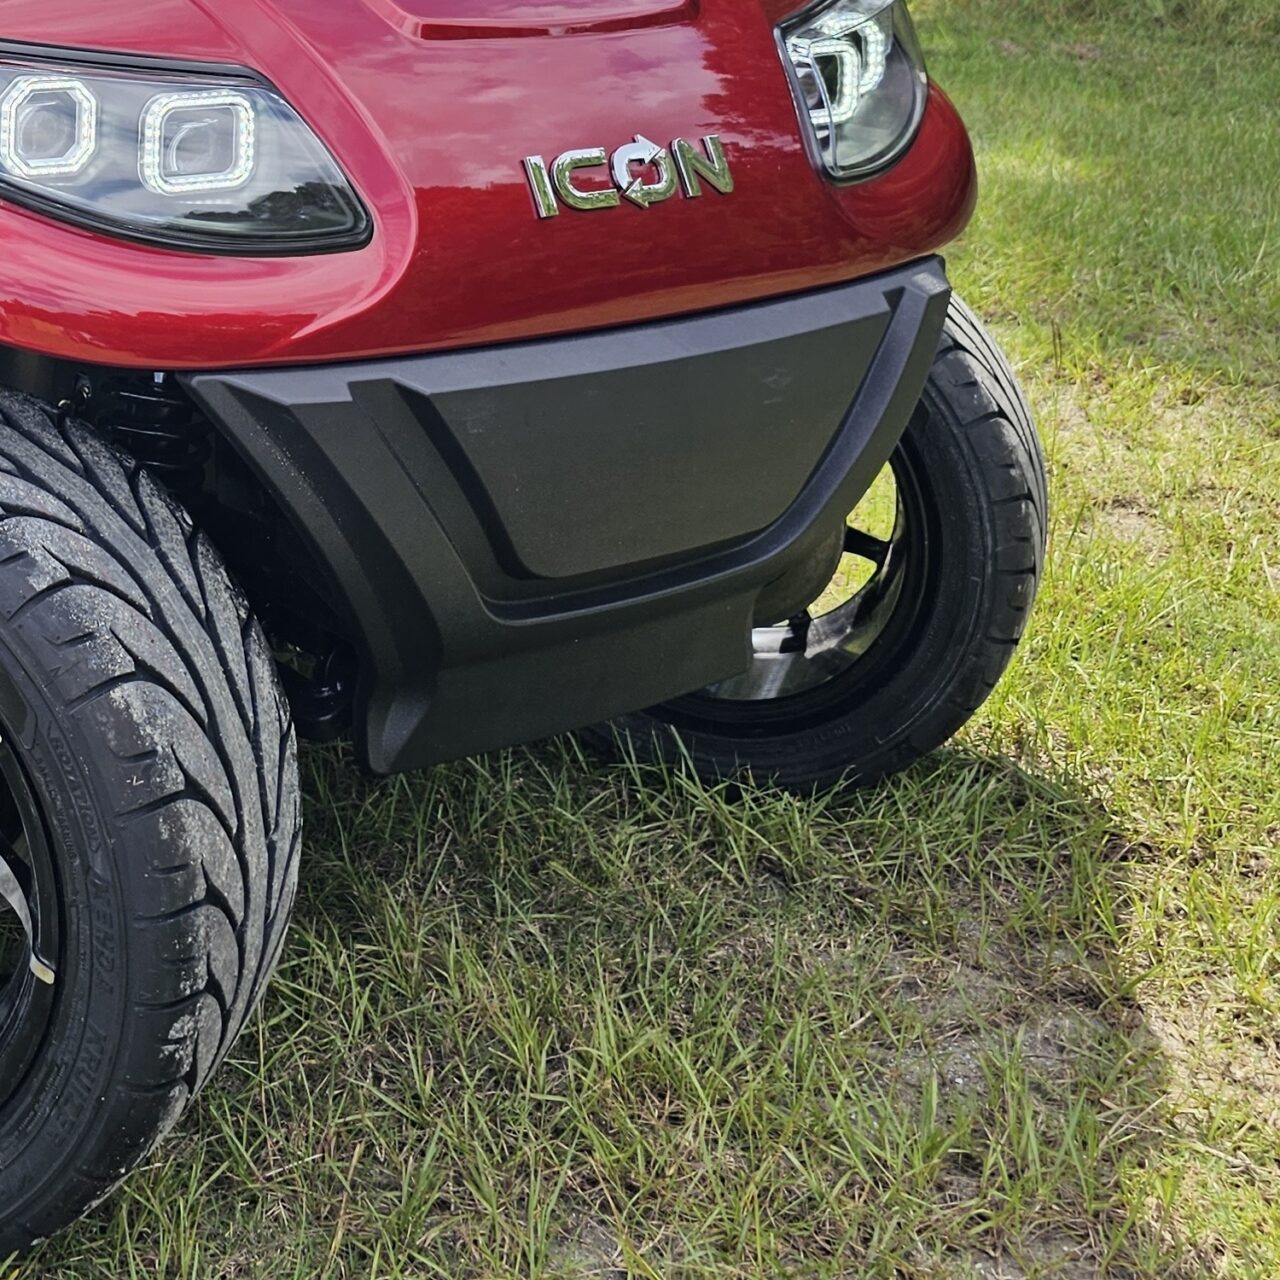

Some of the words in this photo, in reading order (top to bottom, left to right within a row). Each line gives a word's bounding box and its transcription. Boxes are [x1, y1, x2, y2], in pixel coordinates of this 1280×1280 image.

[523, 134, 733, 218] ICON
[50, 735, 98, 843] ROTATION
[87, 877, 115, 995] KENDA
